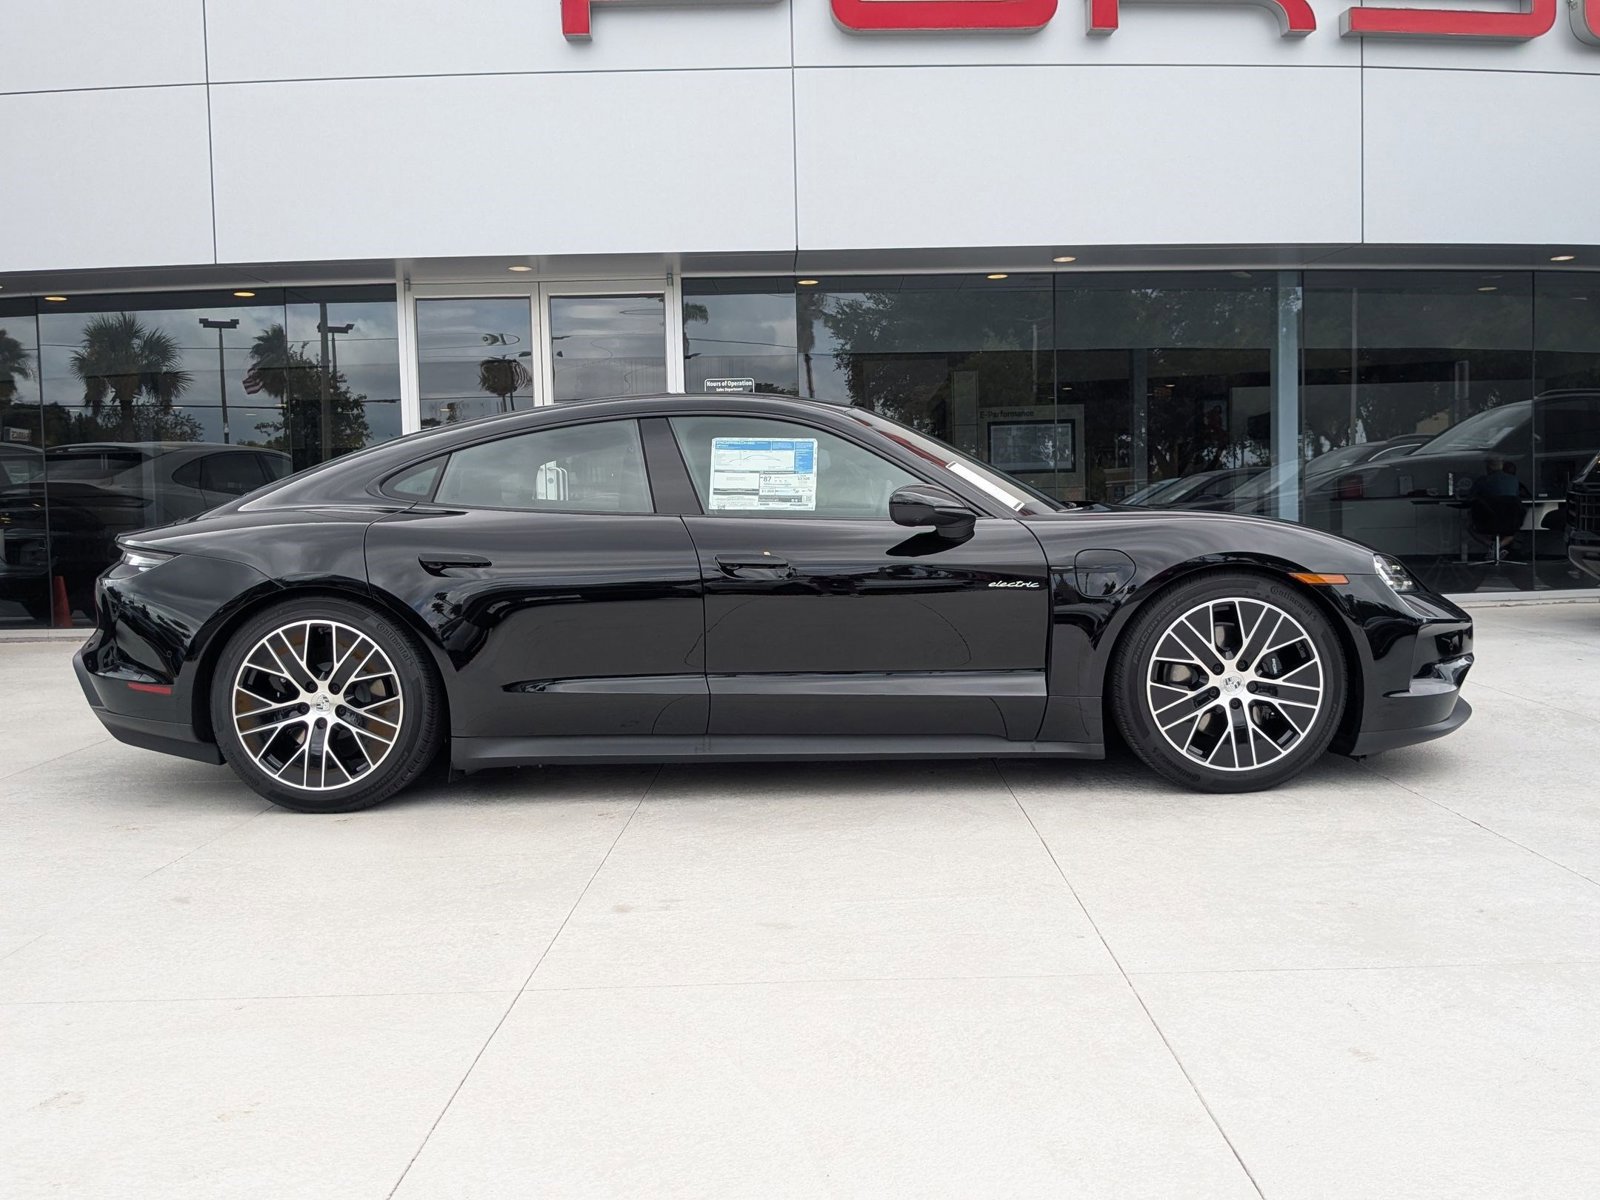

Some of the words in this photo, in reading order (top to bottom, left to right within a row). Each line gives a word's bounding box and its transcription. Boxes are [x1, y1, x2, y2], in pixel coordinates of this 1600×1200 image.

[727, 380, 752, 388] Operation
[979, 410, 1034, 419] E-Performance
[988, 580, 1040, 588] electric
[376, 623, 411, 662] Continental
